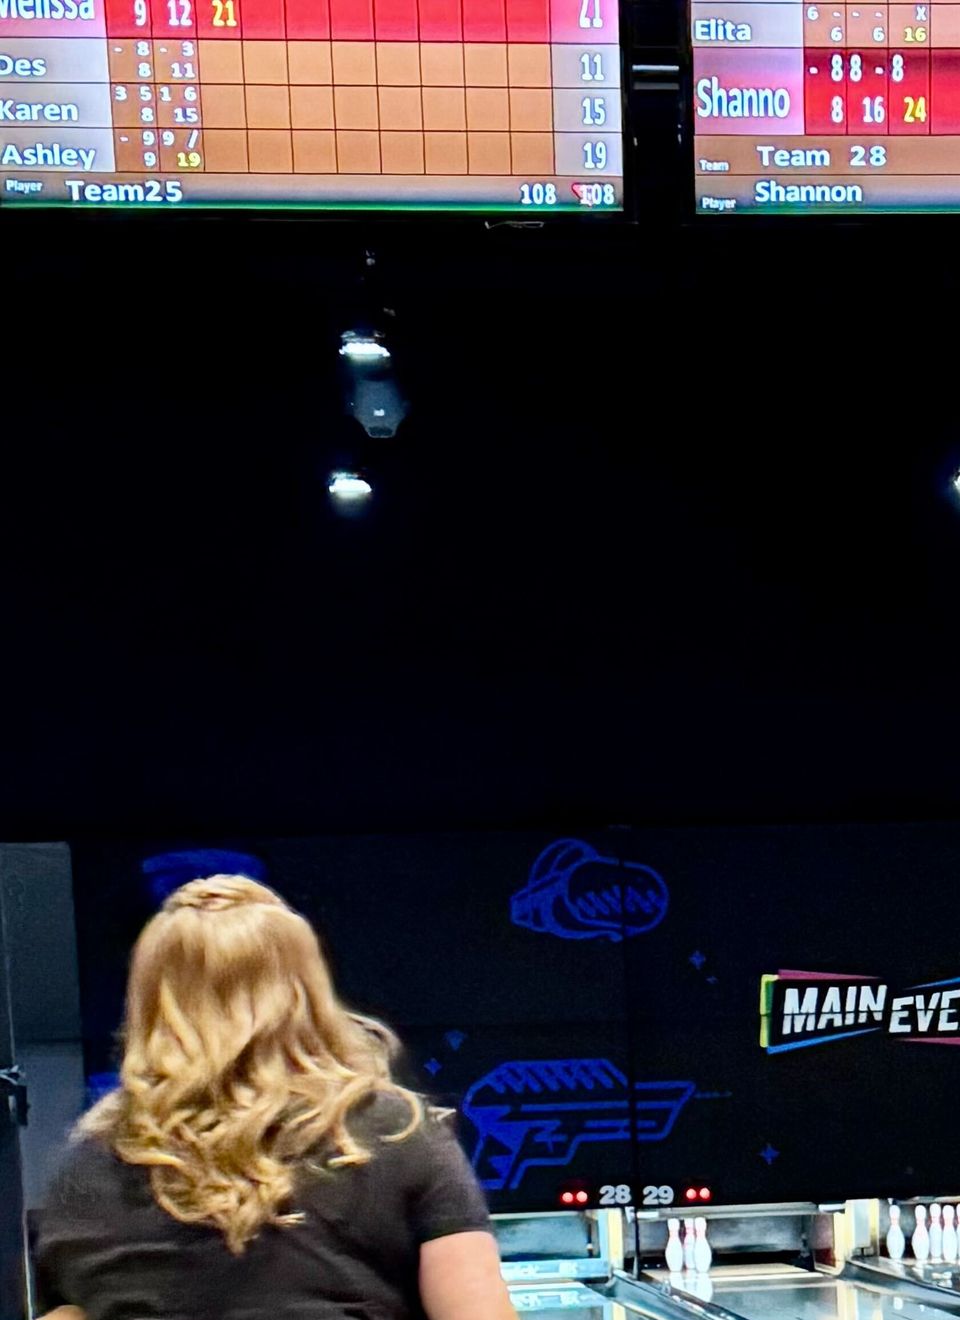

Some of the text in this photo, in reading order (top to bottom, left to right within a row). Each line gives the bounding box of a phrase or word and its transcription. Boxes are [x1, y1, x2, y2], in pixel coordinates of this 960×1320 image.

[134, 0, 238, 27] 9 12 21
[807, 6, 819, 20] 6
[694, 19, 752, 41] Elita
[830, 26, 928, 42] 6 6 16
[136, 41, 194, 56] 8 3
[0, 55, 47, 77] Des
[138, 63, 196, 78] 8 11
[581, 54, 605, 80] 11
[831, 54, 904, 82] 8 8 8
[114, 86, 197, 101] 3 5 1 6
[697, 76, 791, 119] Shanno
[0, 100, 79, 122] Karen
[141, 107, 199, 123] 8 15
[582, 97, 606, 125] 15
[831, 95, 928, 124] 8 16 24
[142, 131, 175, 146] 9 9
[2, 143, 96, 170] Ashley
[144, 151, 201, 167] 9 19
[583, 141, 607, 169] 19
[699, 145, 887, 172] Team Team 28
[6, 179, 183, 202] Player Team25
[520, 183, 557, 205] 108
[702, 180, 863, 211] Player Shannon
[781, 984, 888, 1035] MAIN
[599, 1184, 674, 1205] 28 29
